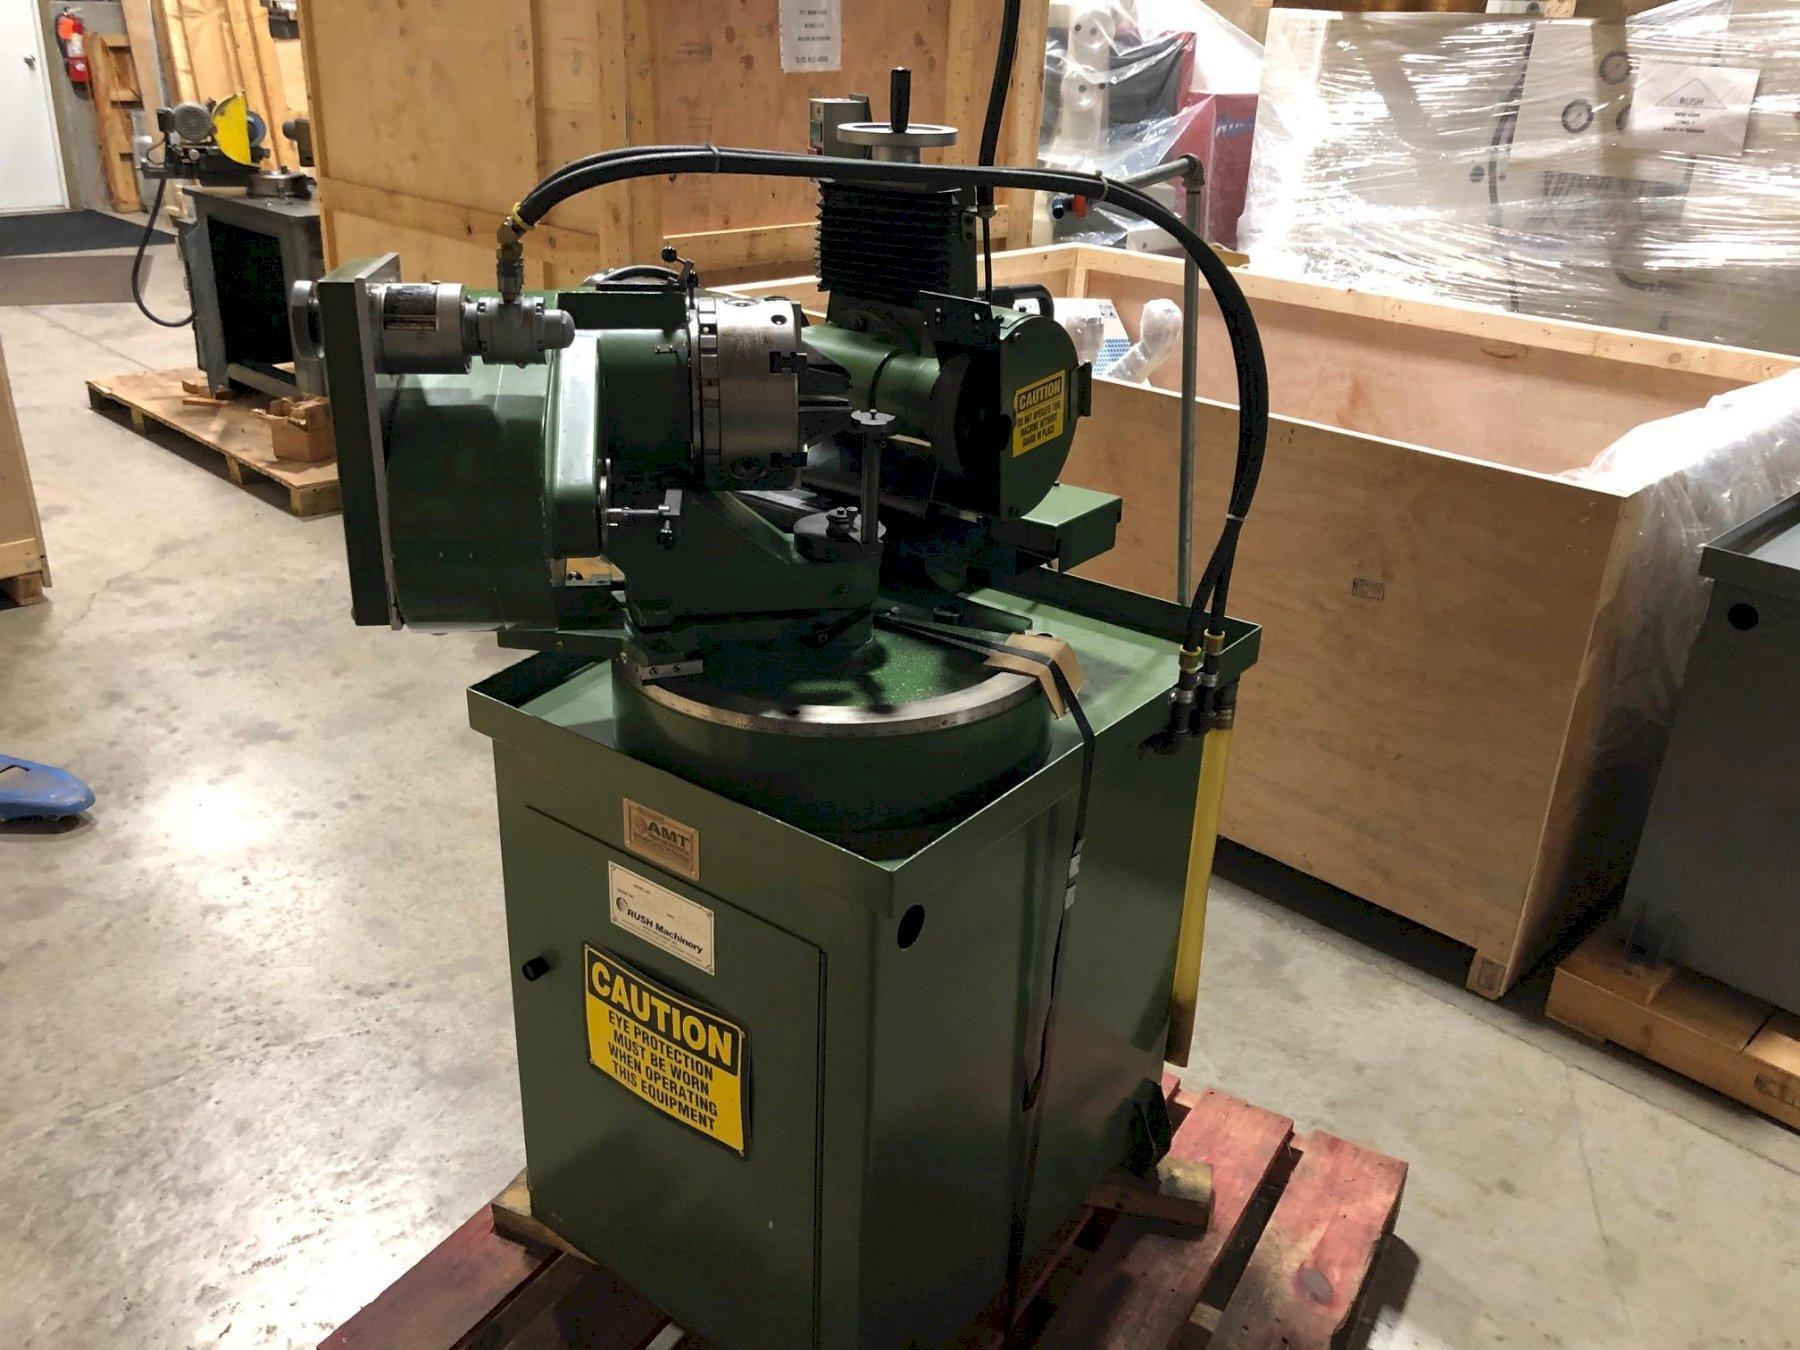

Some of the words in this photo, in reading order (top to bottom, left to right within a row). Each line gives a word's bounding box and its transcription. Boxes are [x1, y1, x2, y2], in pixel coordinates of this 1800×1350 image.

[1019, 379, 1061, 410] CAUTION
[648, 822, 690, 847] AMT
[627, 908, 654, 927] RUSH
[655, 922, 703, 954] Machinery
[592, 961, 732, 1066] CAUTION
[608, 1009, 630, 1034] EYE
[633, 1025, 713, 1081] PROTECTION
[608, 1041, 642, 1075] WHEN
[645, 1066, 718, 1117] OPERATING
[612, 1060, 638, 1088] THIS
[640, 1078, 716, 1131] EQUIPMENT
[613, 1029, 646, 1060] MUST
[650, 1052, 666, 1073] BE
[670, 1063, 709, 1097] WORN
